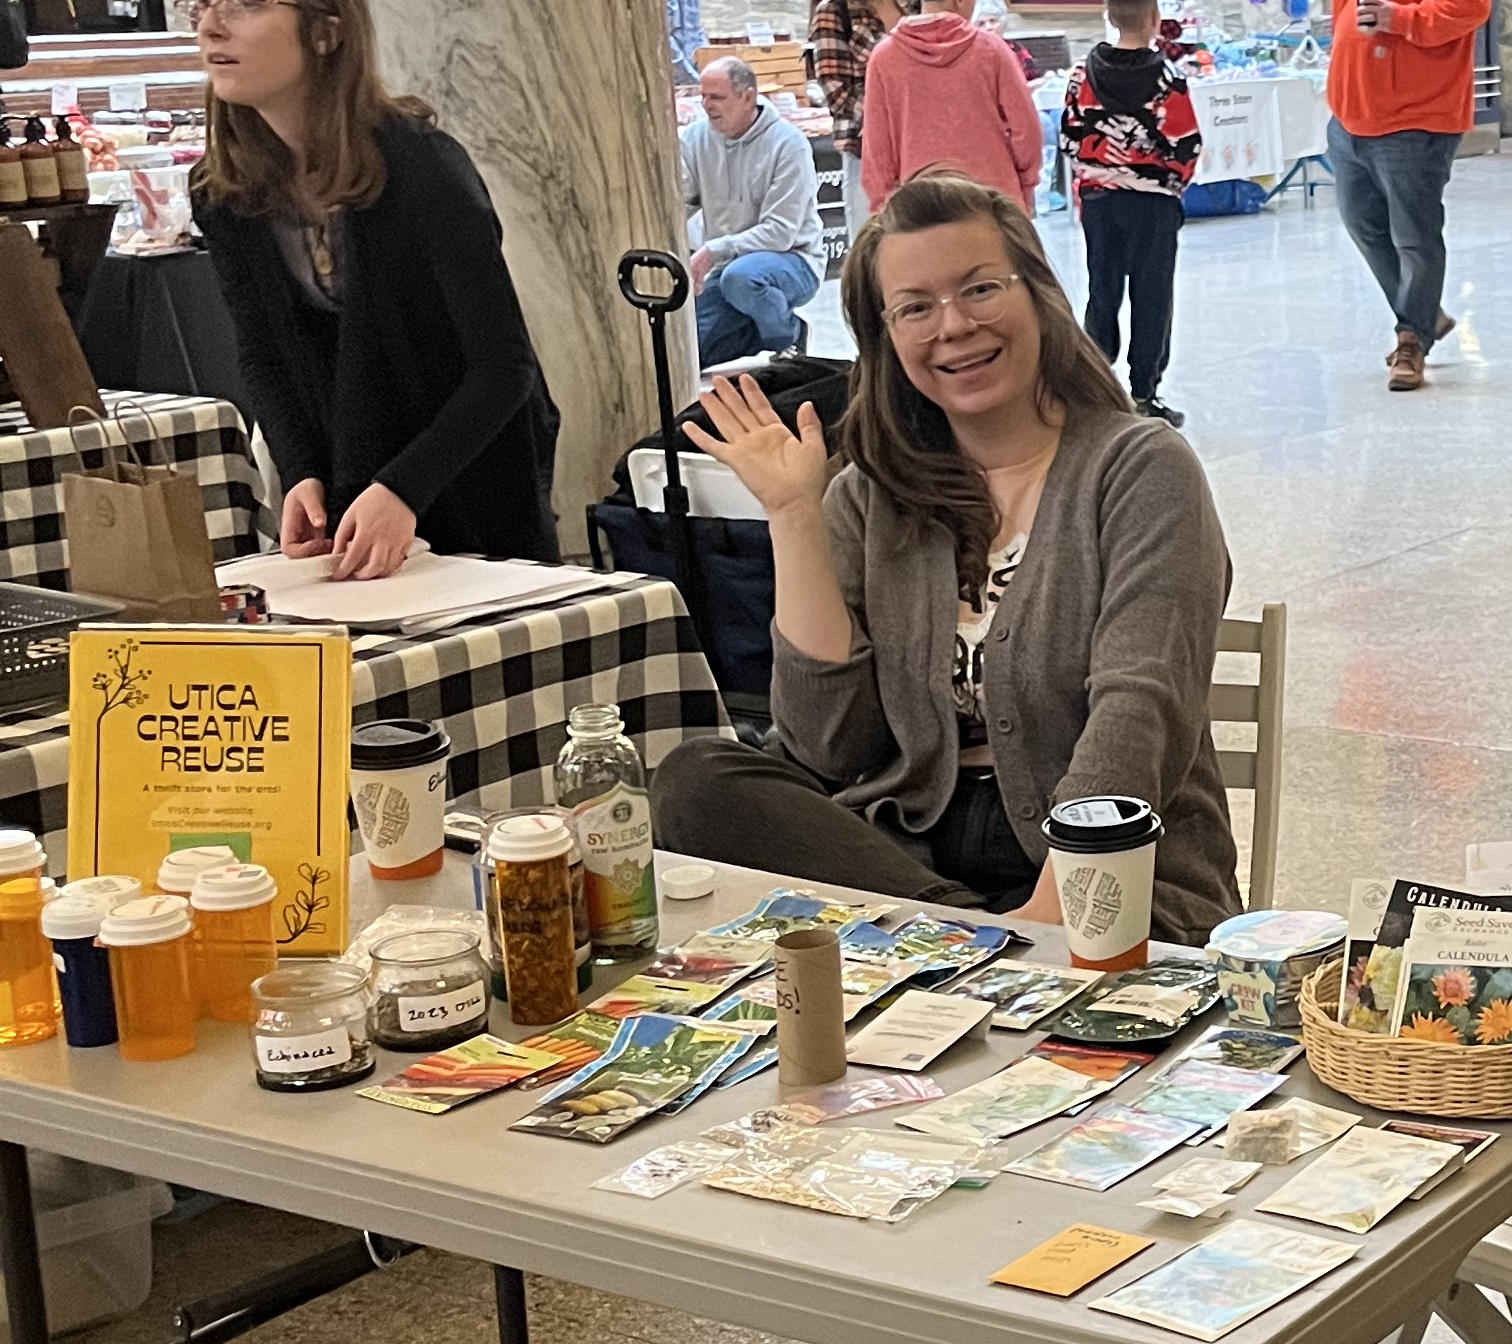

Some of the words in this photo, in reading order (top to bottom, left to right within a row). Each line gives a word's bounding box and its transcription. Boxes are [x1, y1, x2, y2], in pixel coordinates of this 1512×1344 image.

[169, 684, 259, 710] UTICA
[137, 715, 290, 741] CREATIVE
[161, 746, 264, 772] REUSE
[143, 784, 149, 792] A
[216, 785, 231, 793] for
[235, 785, 254, 793] the
[1456, 917, 1484, 927] Seed
[1437, 951, 1509, 962] CALENDULA
[1231, 983, 1261, 1000] GROW
[1240, 998, 1256, 1012] KIT
[408, 1006, 448, 1021] 2023
